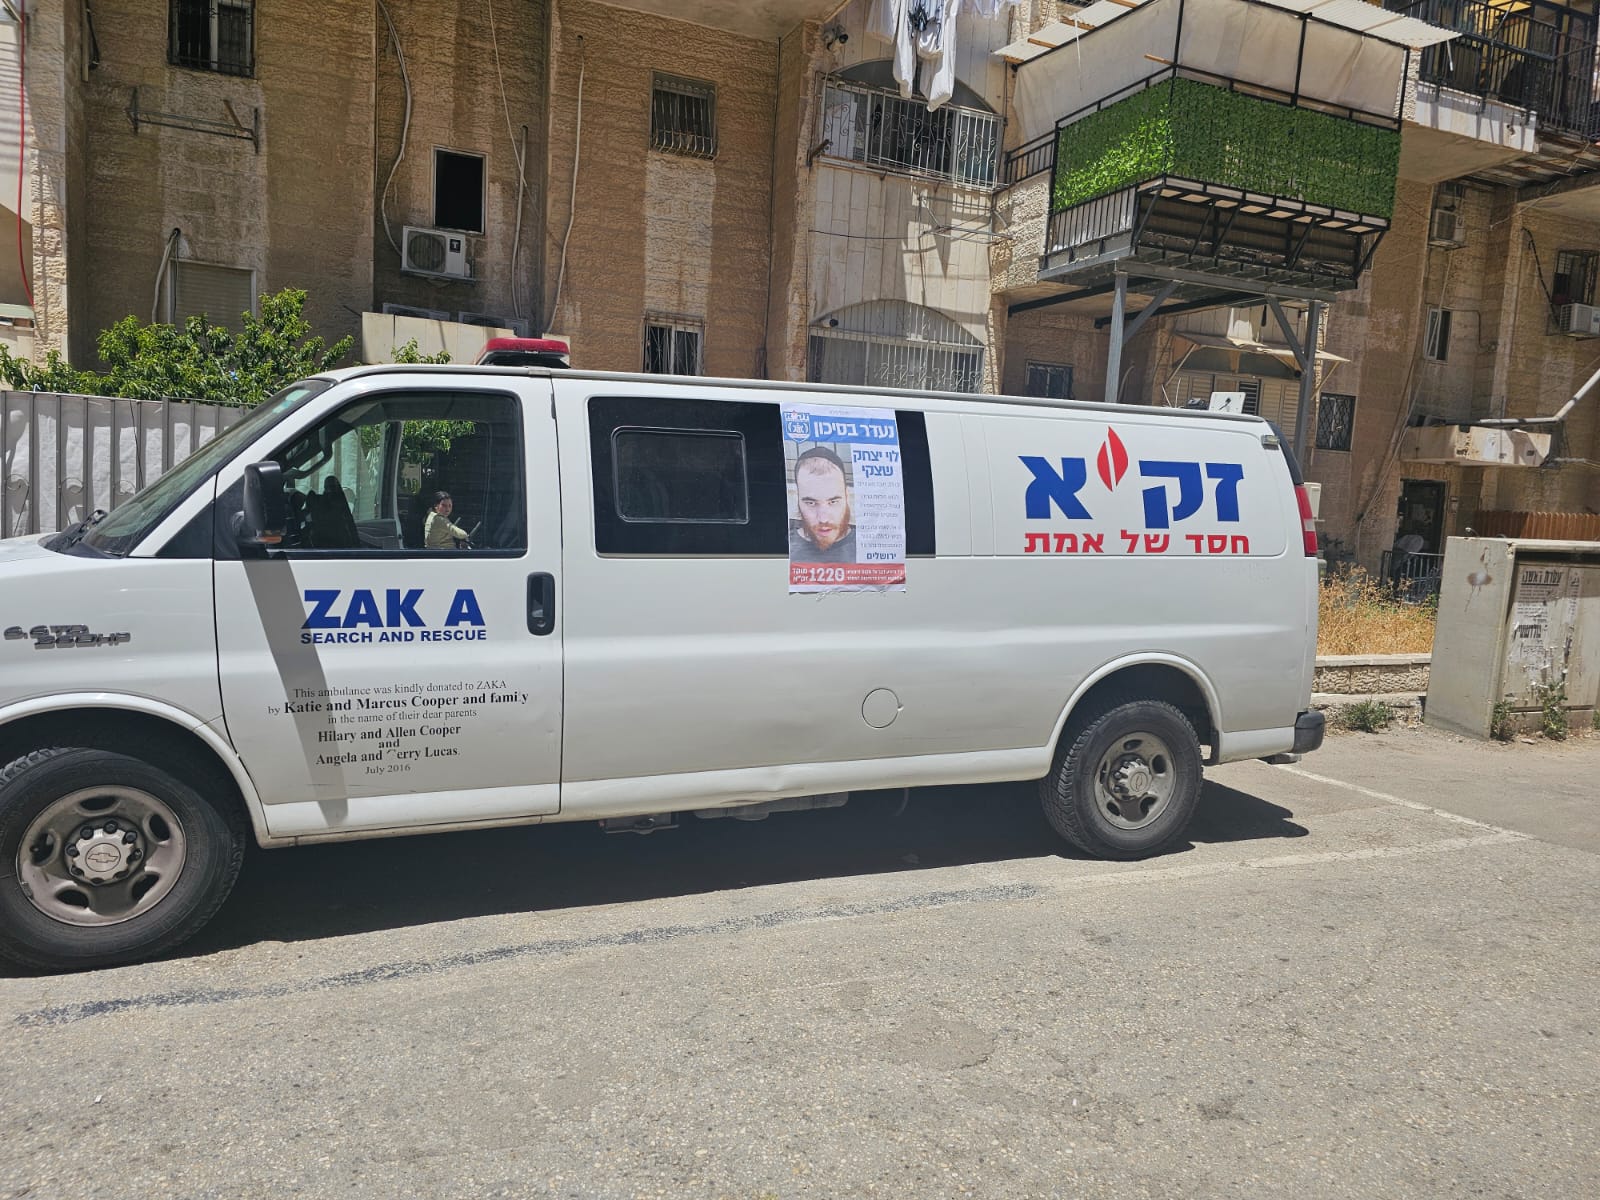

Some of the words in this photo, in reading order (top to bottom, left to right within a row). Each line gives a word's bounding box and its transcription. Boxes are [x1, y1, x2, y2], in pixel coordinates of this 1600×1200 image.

[813, 421, 859, 438] בסיכון
[860, 424, 895, 439] נעדר
[853, 450, 882, 462] יצחק
[886, 450, 899, 462] לוי
[1024, 532, 1104, 553] אמת
[1120, 529, 1170, 554] של
[1186, 534, 1250, 554] חסד
[866, 552, 897, 560] ירושלים
[809, 567, 845, 582] 1220
[301, 631, 373, 644] SEARCH
[378, 630, 415, 643] AND
[420, 629, 487, 642] RESCUE
[294, 688, 315, 698] This
[318, 686, 371, 697] ambulance
[373, 687, 392, 695] was
[394, 684, 424, 694] kindly
[426, 682, 463, 692] donated
[465, 682, 474, 690] to
[476, 680, 507, 690] ZAKA
[268, 706, 281, 716] by
[284, 700, 322, 714] Katie
[326, 699, 351, 711] and
[356, 698, 407, 710] Marcus
[411, 695, 459, 708] Cooper
[462, 693, 486, 704] and
[490, 691, 528, 704] famiy
[328, 715, 337, 724] in
[340, 714, 355, 723] the
[358, 715, 383, 723] name
[386, 711, 398, 721] of
[398, 710, 420, 720] their
[422, 709, 442, 720] dear
[444, 709, 477, 720] parents
[318, 730, 356, 743] Hilary
[360, 728, 382, 740] and
[385, 726, 416, 738] Allen
[420, 725, 461, 738] Cooper
[378, 739, 400, 748] and
[316, 751, 357, 766] Angela
[361, 750, 382, 761] and
[386, 748, 421, 760] erry
[425, 747, 458, 758] Lucas
[365, 766, 385, 775] July
[387, 763, 411, 773] 2016
